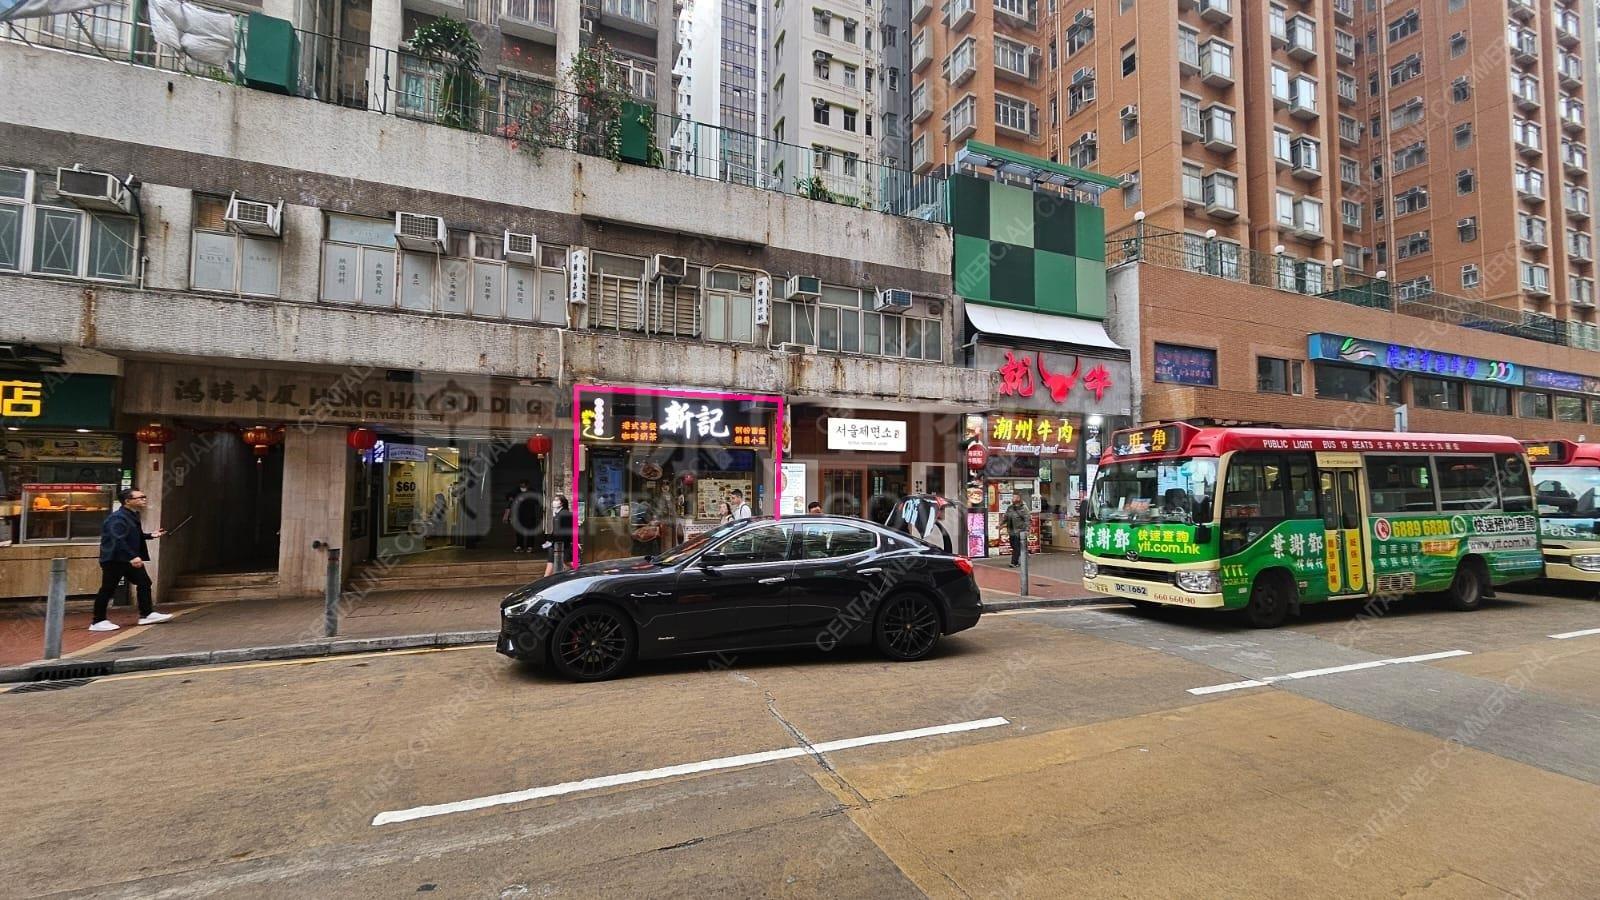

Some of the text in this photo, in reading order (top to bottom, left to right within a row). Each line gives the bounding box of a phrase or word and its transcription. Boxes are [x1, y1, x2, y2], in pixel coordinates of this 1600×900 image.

[660, 400, 730, 439] 新記
[836, 423, 892, 439] 서울제면소
[993, 416, 1074, 443] 潮州牛肉
[1129, 429, 1166, 447] 旺角
[1263, 439, 1288, 449] PUBLIC
[1293, 440, 1313, 449] LIGHT
[1322, 440, 1336, 449] BUS
[1340, 441, 1348, 449] 19
[1352, 440, 1373, 449] SEATS
[1005, 442, 1040, 456] Amazing
[396, 482, 416, 492] $60
[1137, 529, 1190, 543] 快速查詢
[1392, 520, 1421, 538] 6889
[1541, 524, 1577, 537] Pets
[1137, 540, 1201, 555] ytt.com.hk
[1270, 532, 1323, 559] 葉謝鄧
[1114, 583, 1125, 592] DC
[1127, 585, 1147, 595] 1662
